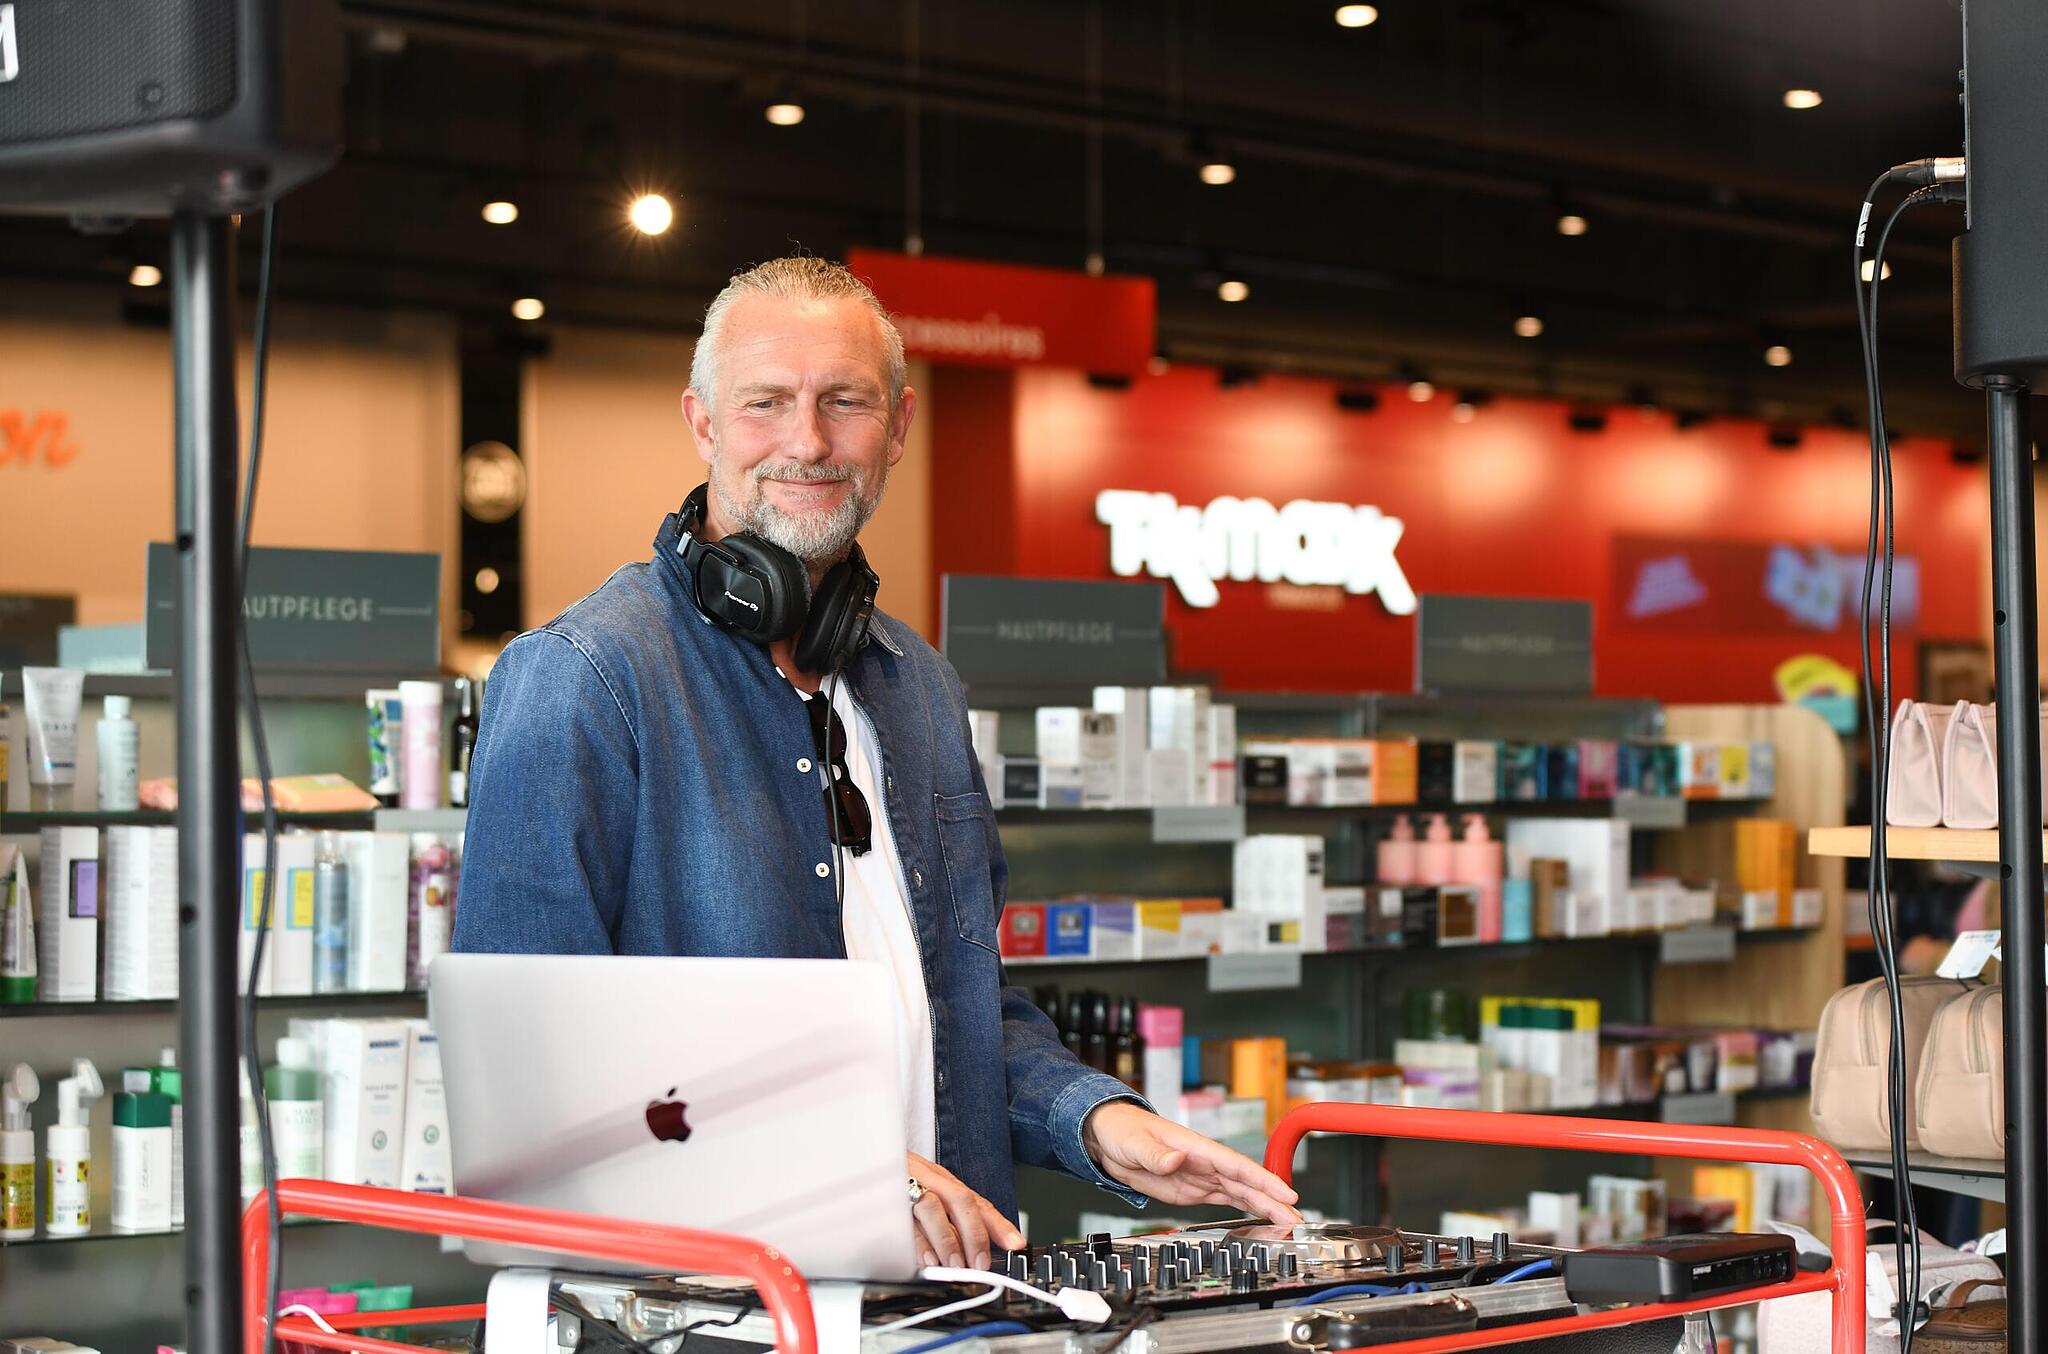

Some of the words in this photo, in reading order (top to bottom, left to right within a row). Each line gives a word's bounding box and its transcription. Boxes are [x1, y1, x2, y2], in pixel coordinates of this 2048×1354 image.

[240, 595, 373, 621] AUTPFLEGE
[724, 591, 750, 606] Pioneer
[997, 619, 1114, 642] HAUTPFLEGE
